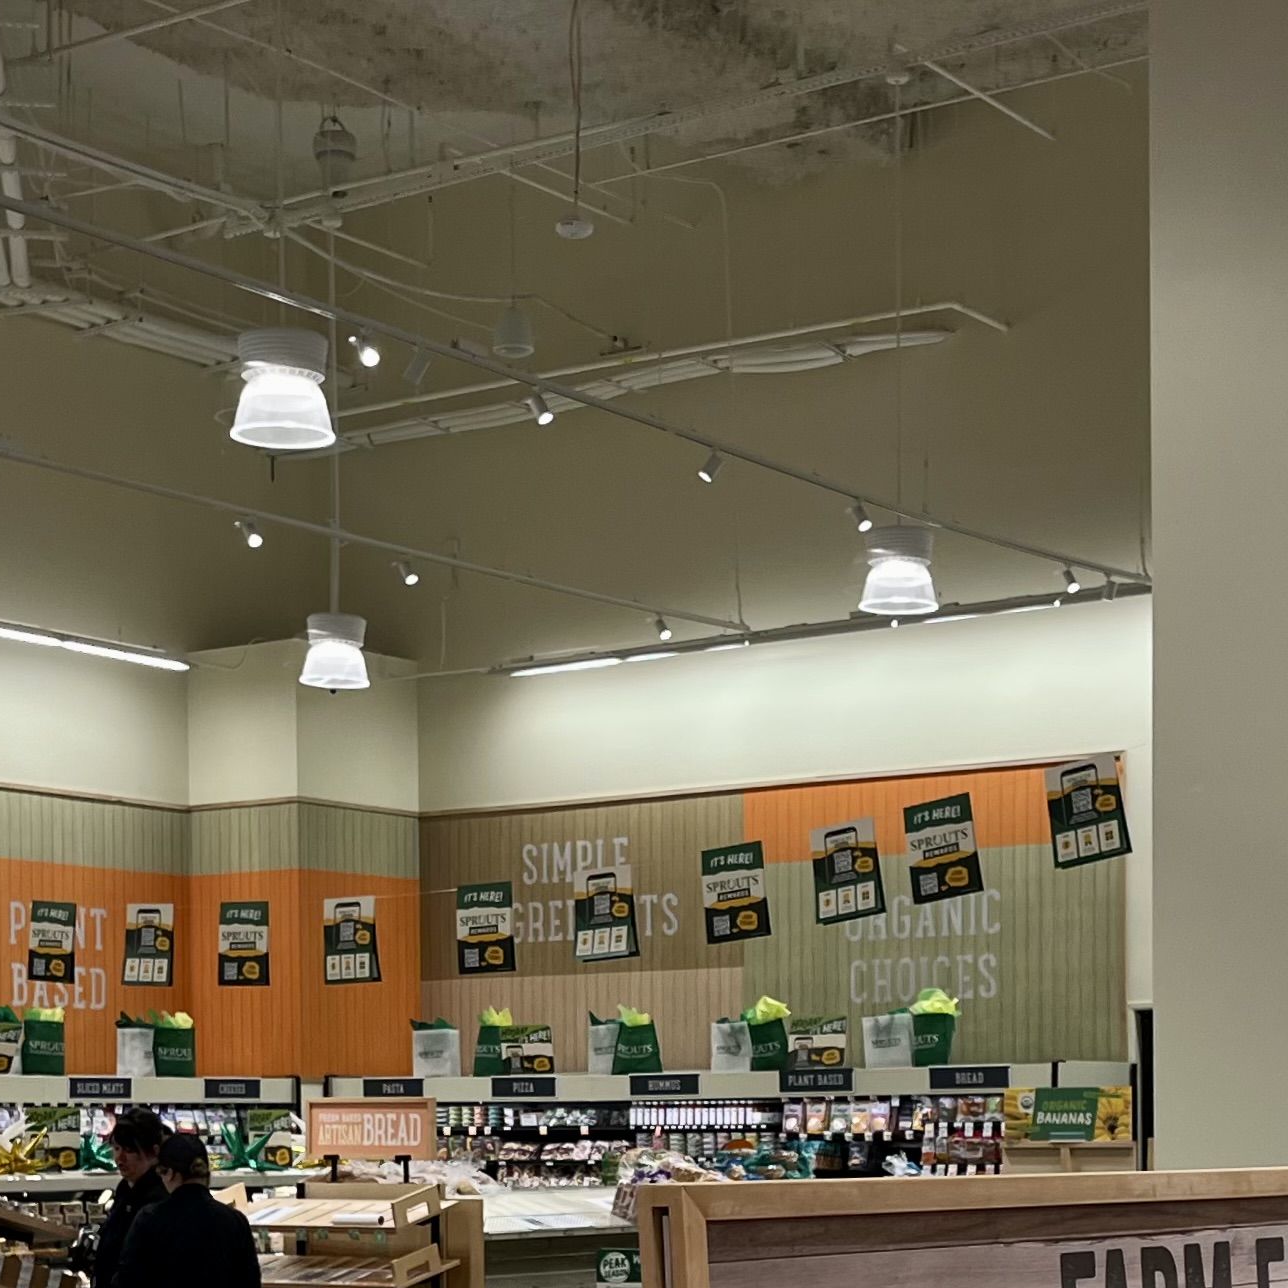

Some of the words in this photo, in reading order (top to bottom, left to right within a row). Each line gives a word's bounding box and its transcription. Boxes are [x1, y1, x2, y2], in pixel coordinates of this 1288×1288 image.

[909, 828, 969, 852] SPROUTS
[521, 836, 630, 885] SIMPLE
[9, 901, 107, 950] PNT
[11, 963, 107, 1010] BASED
[849, 953, 998, 1003] CHOICES
[512, 1081, 534, 1093] PIZZA
[787, 1074, 817, 1087] PLANT
[818, 1073, 844, 1086] BASED
[955, 1072, 984, 1084] BREAD
[382, 1083, 405, 1095] PASTA
[1036, 1111, 1093, 1126] BANANAS
[317, 1125, 362, 1146] ARTISAN
[363, 1113, 422, 1147] BREAD
[602, 1257, 627, 1270] PEAK
